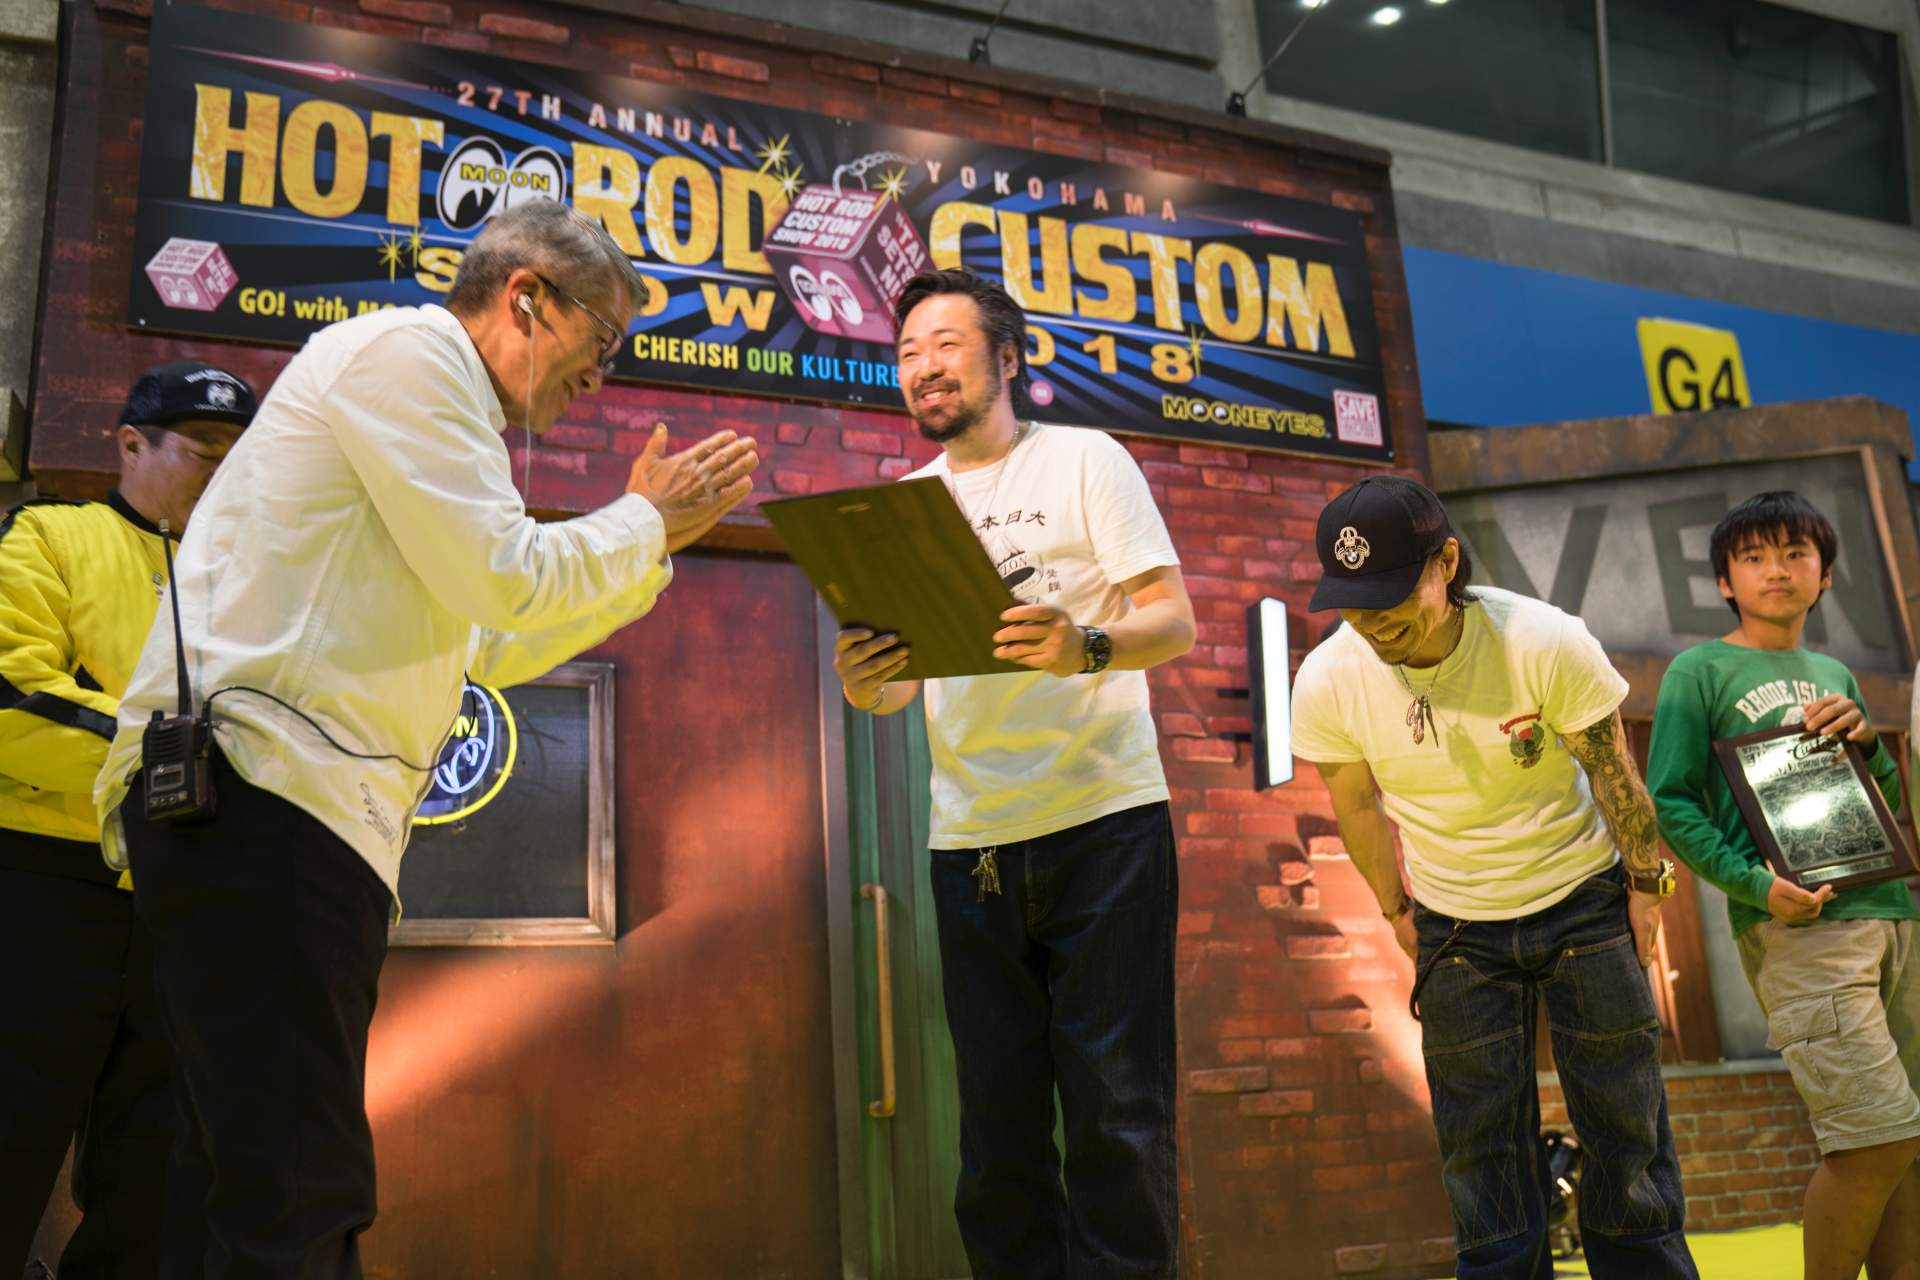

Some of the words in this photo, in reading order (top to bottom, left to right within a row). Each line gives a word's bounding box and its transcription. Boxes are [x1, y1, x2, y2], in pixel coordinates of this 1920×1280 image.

[457, 81, 561, 121] 27TH
[588, 104, 743, 151] ANNUAL
[460, 162, 552, 192] MOON
[927, 158, 1177, 222] YOKOHAMA
[188, 83, 445, 227] HOT
[570, 140, 790, 276] ROD
[928, 200, 1356, 359] CUSTOM
[784, 210, 863, 237] CUSTOM
[832, 199, 875, 219] ROD
[772, 226, 817, 246] SHOW
[238, 287, 286, 317] GO!
[294, 296, 349, 322] with
[633, 333, 739, 370] CHERISH
[747, 347, 794, 377] OUR
[801, 354, 900, 389] KULTURE
[1658, 347, 1742, 412] G4
[1734, 679, 1795, 724] RHODE
